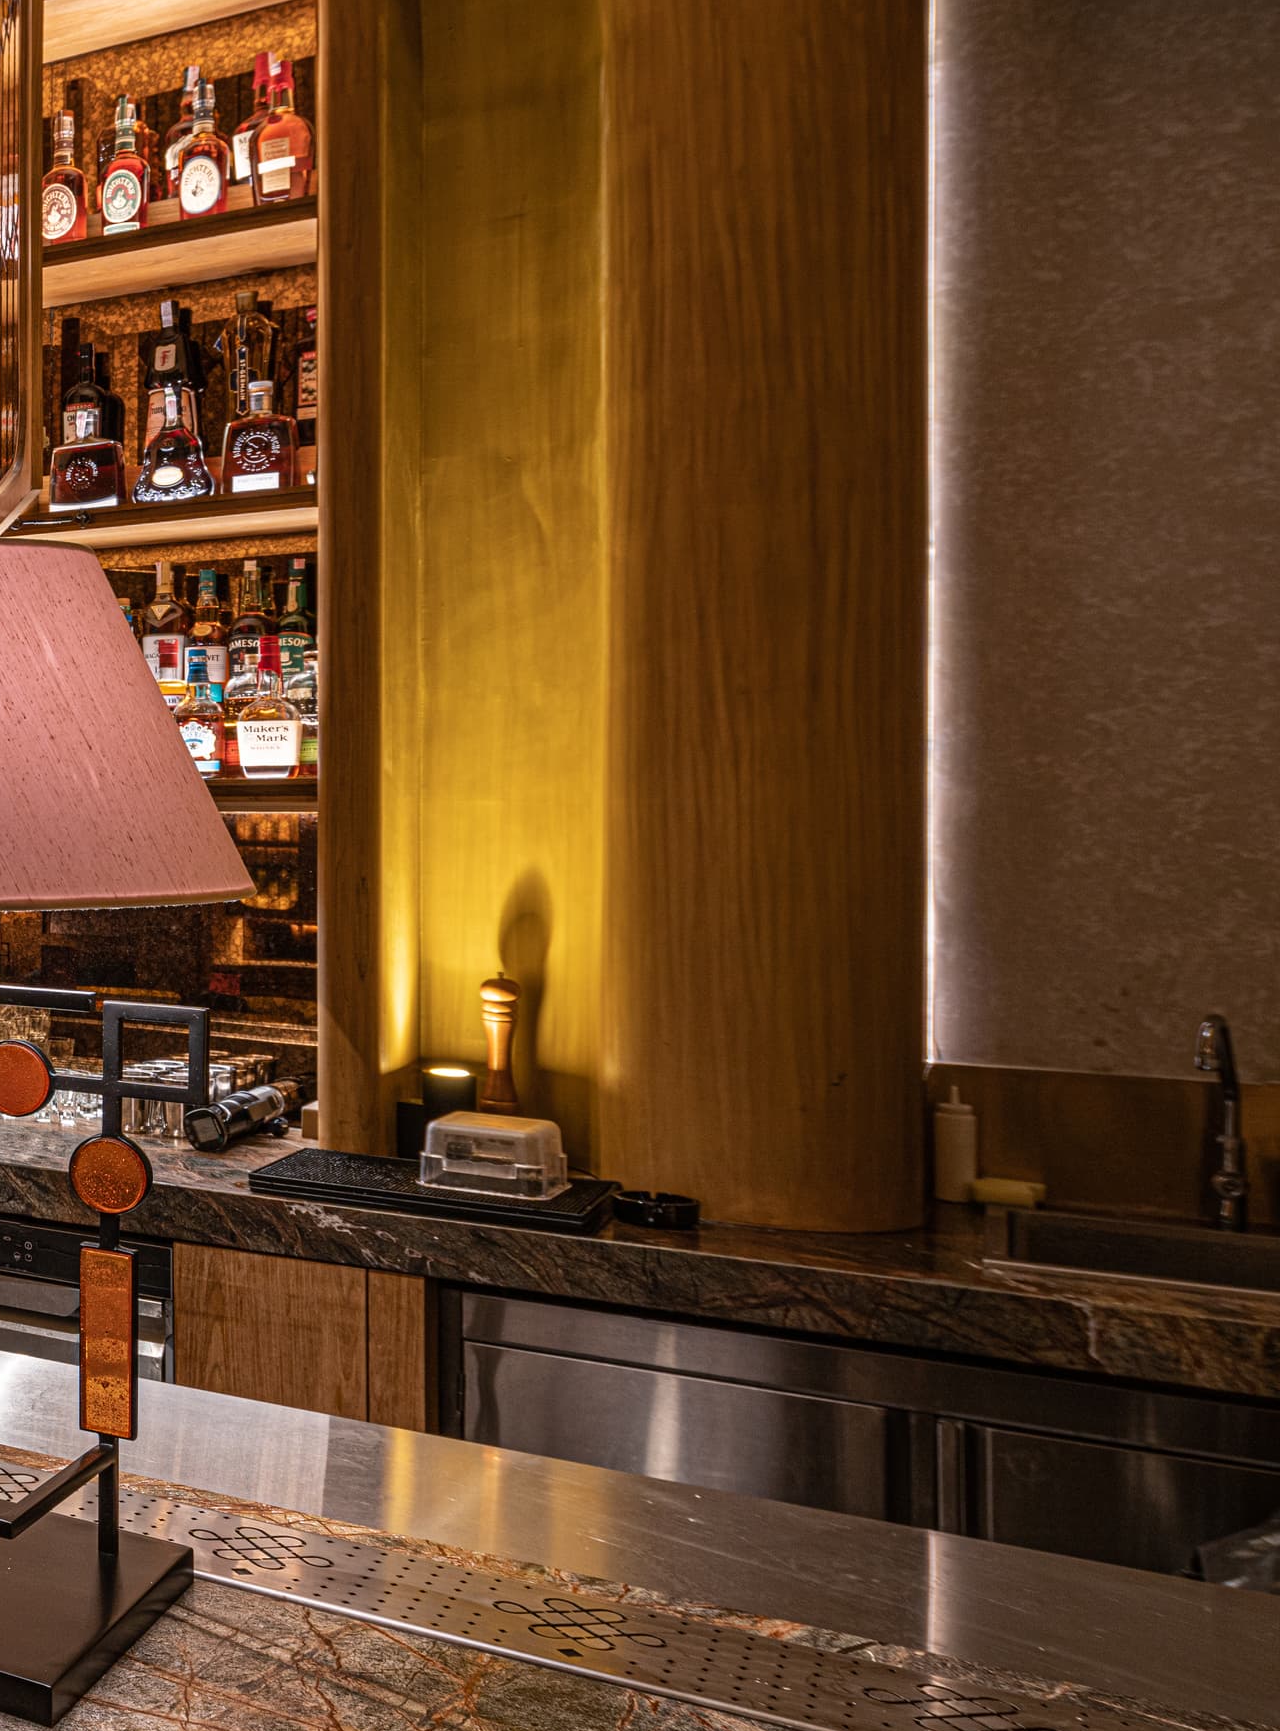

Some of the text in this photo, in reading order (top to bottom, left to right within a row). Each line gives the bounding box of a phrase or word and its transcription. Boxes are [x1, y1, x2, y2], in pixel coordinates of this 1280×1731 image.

[228, 639, 260, 651] JAMESO
[243, 725, 289, 733] Maker's
[255, 734, 288, 742] Mark
